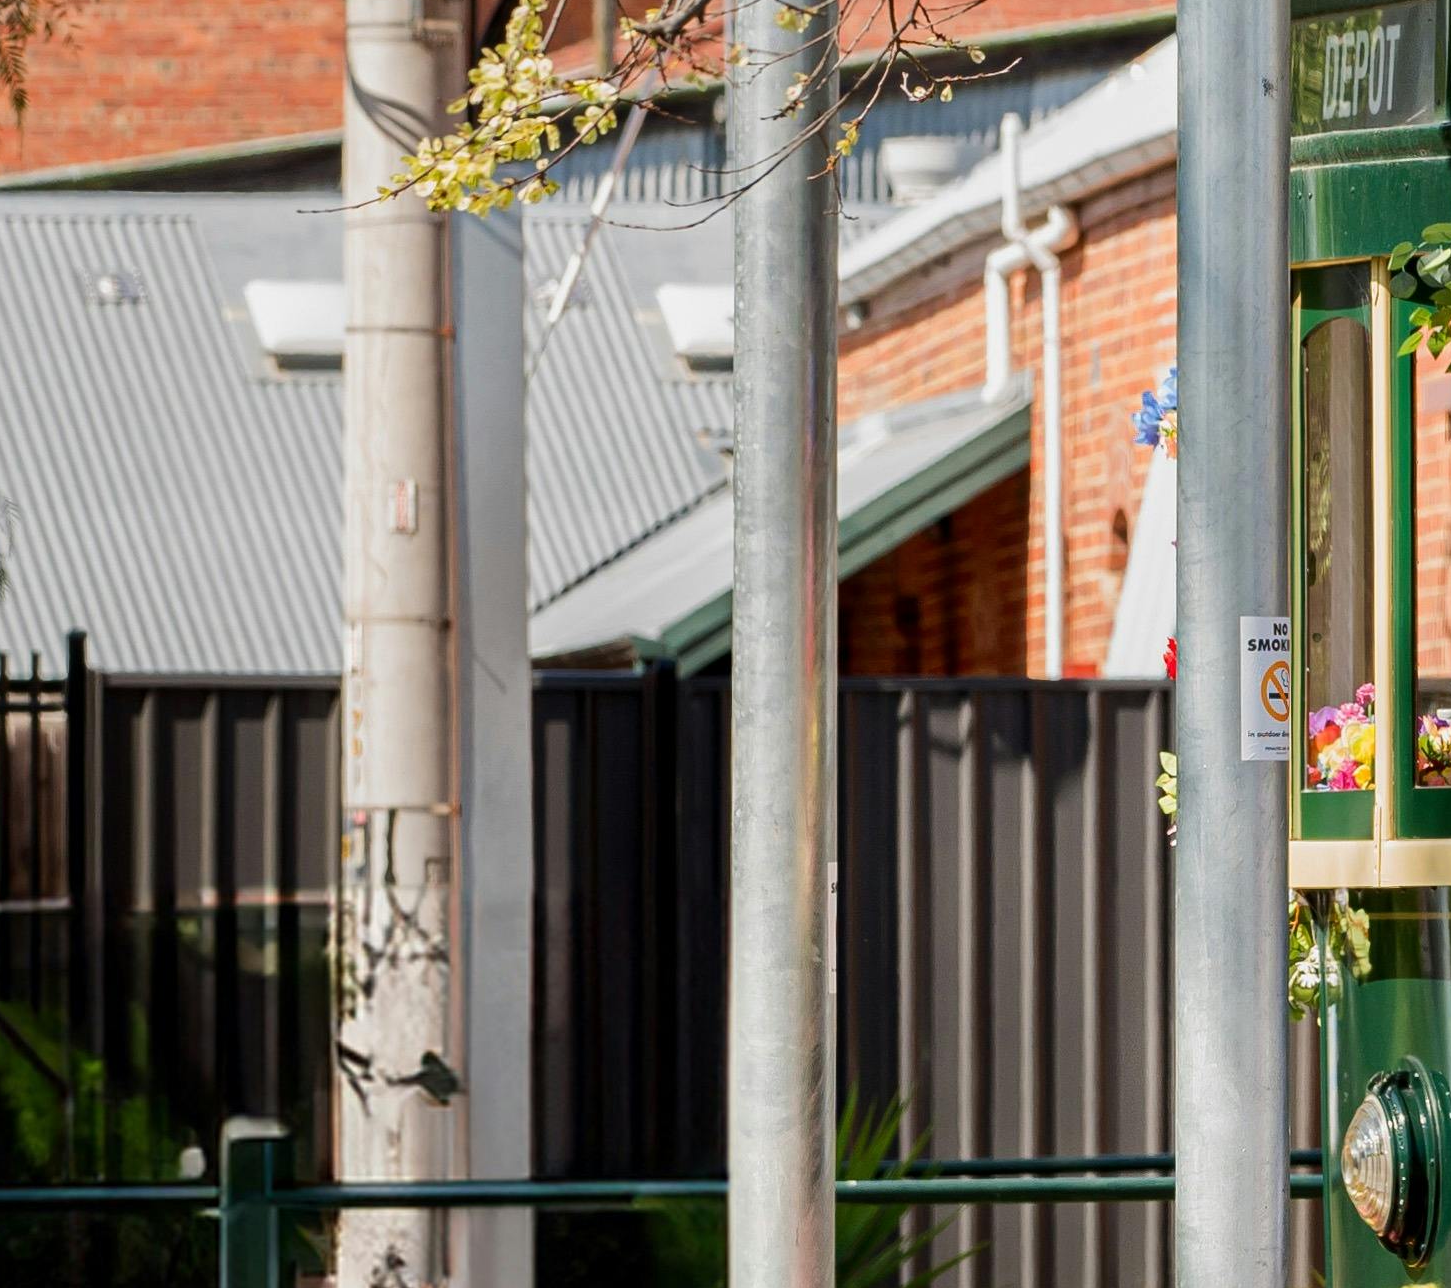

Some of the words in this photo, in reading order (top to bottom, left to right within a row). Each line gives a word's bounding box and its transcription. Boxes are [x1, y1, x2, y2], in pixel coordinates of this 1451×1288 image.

[1322, 23, 1401, 120] DEPOT
[1273, 622, 1289, 636] NO
[1247, 638, 1290, 652] SMOKI
